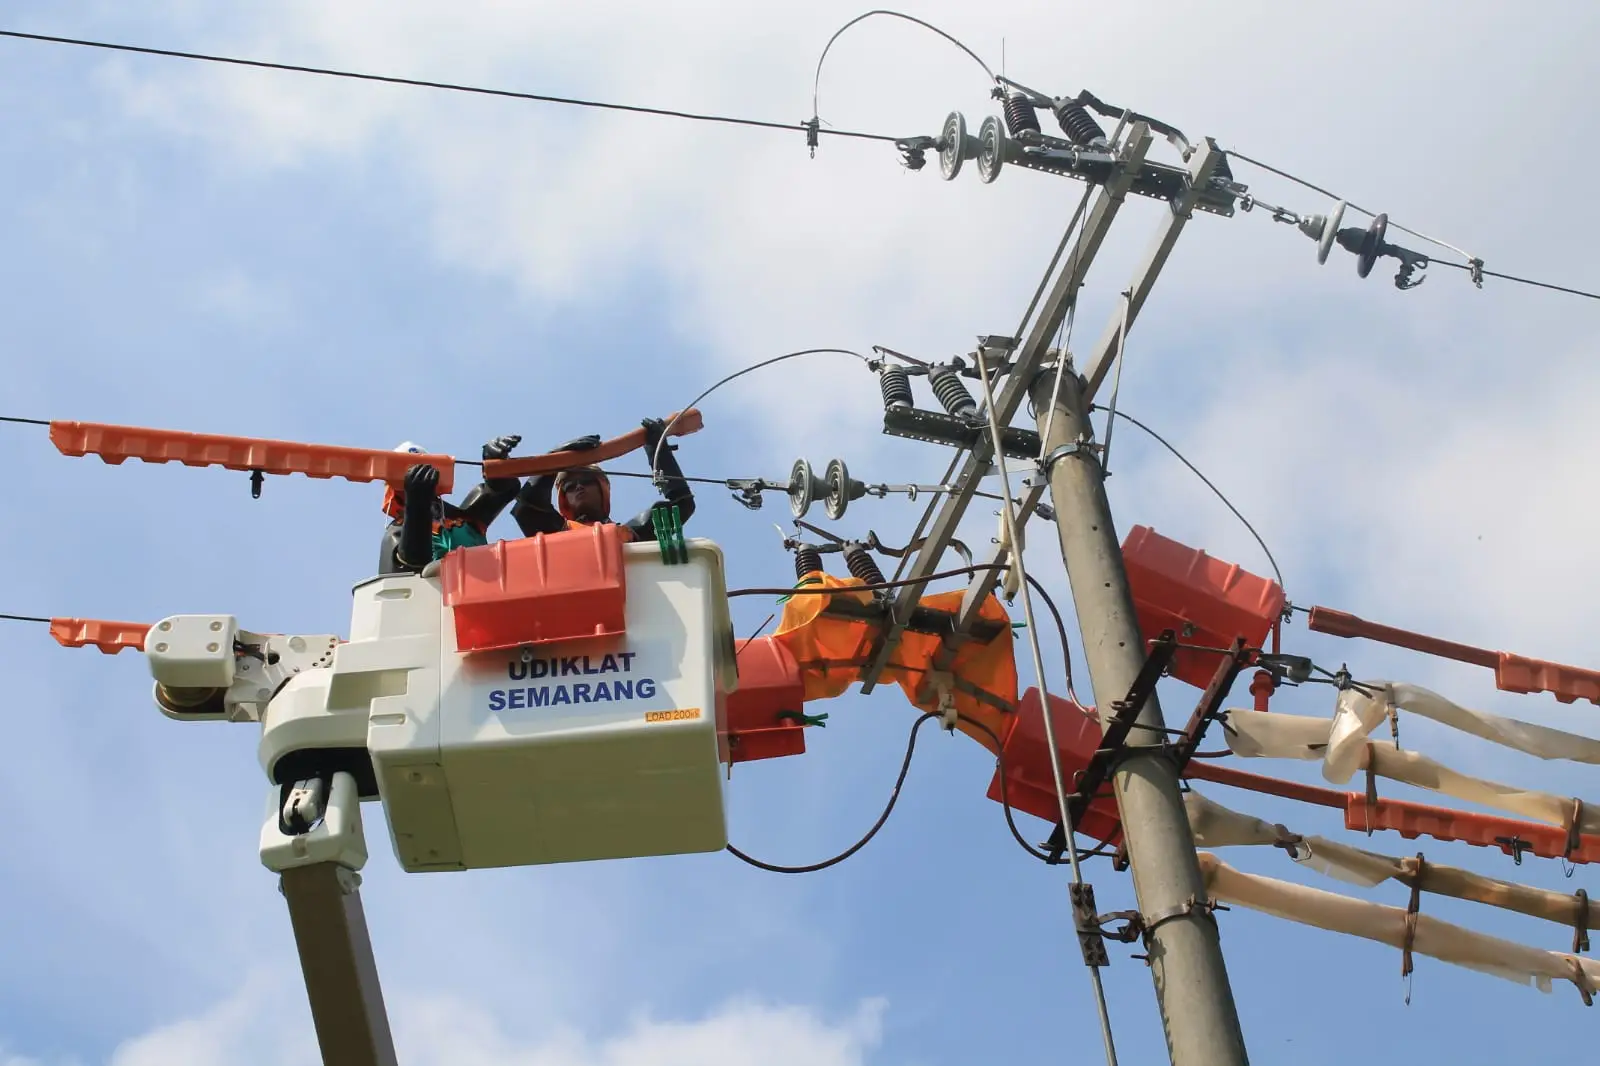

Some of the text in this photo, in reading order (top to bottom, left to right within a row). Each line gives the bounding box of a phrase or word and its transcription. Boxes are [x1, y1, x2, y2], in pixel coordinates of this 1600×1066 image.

[508, 652, 636, 680] UDIKLAT
[488, 678, 656, 711] SEMARANG
[645, 711, 672, 722] LOAD
